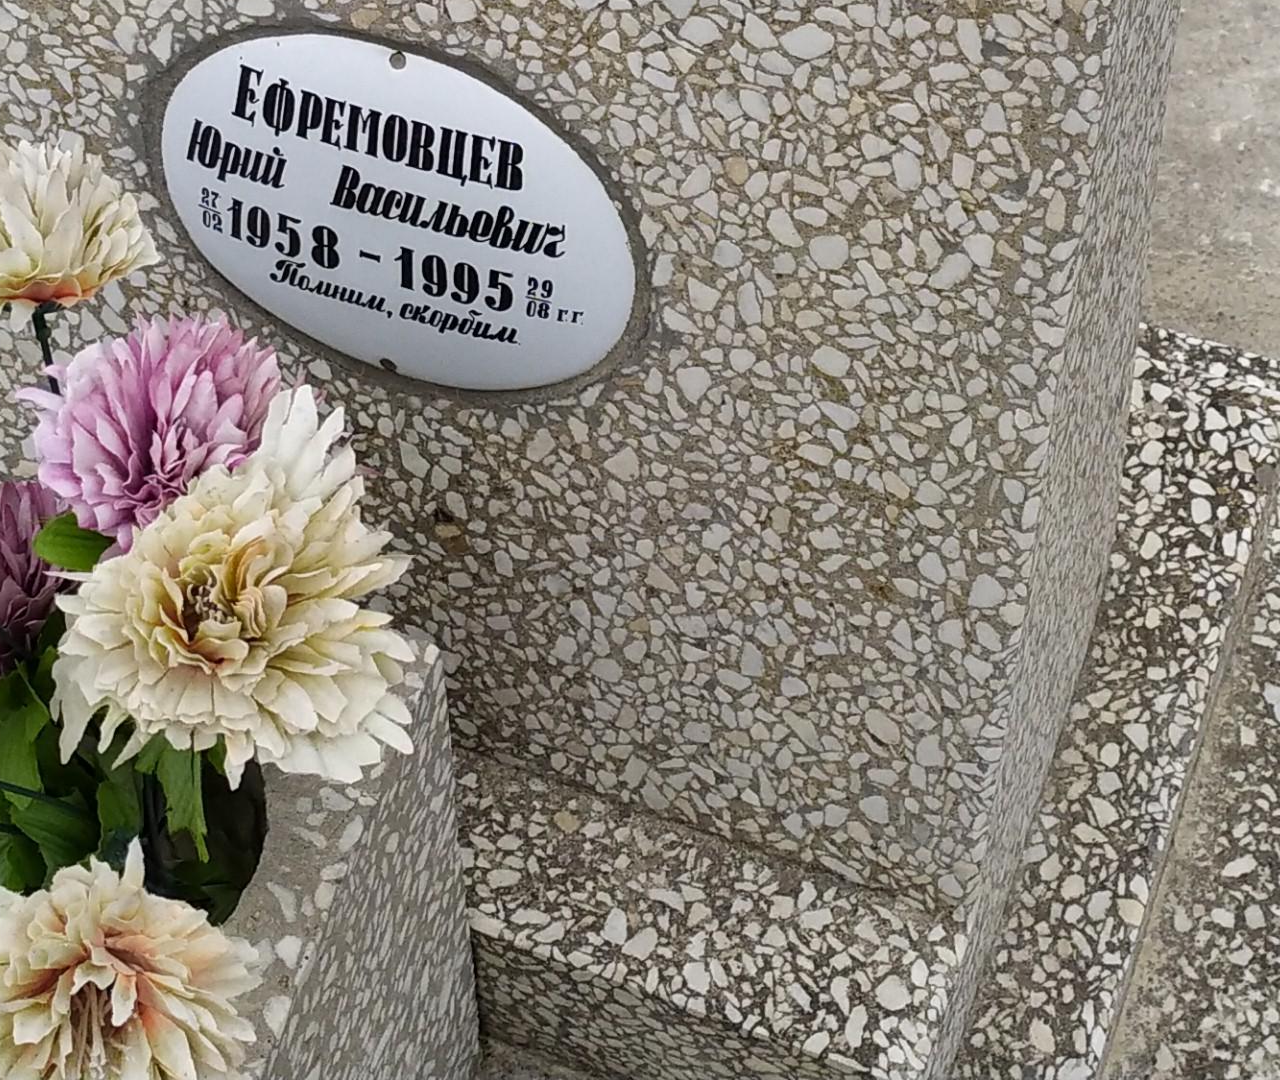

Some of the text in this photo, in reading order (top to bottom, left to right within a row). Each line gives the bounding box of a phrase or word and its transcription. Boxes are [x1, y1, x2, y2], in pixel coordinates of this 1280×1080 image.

[230, 64, 525, 192] ЕФРЕМОВЦЕВ
[186, 118, 566, 258] Юрий Васильевич
[201, 187, 220, 209] 27
[202, 210, 223, 233] 02
[227, 197, 341, 270] 1958
[394, 245, 514, 312] 1995
[269, 259, 394, 319] Помним,
[527, 276, 553, 299] 29
[526, 300, 551, 320] 08
